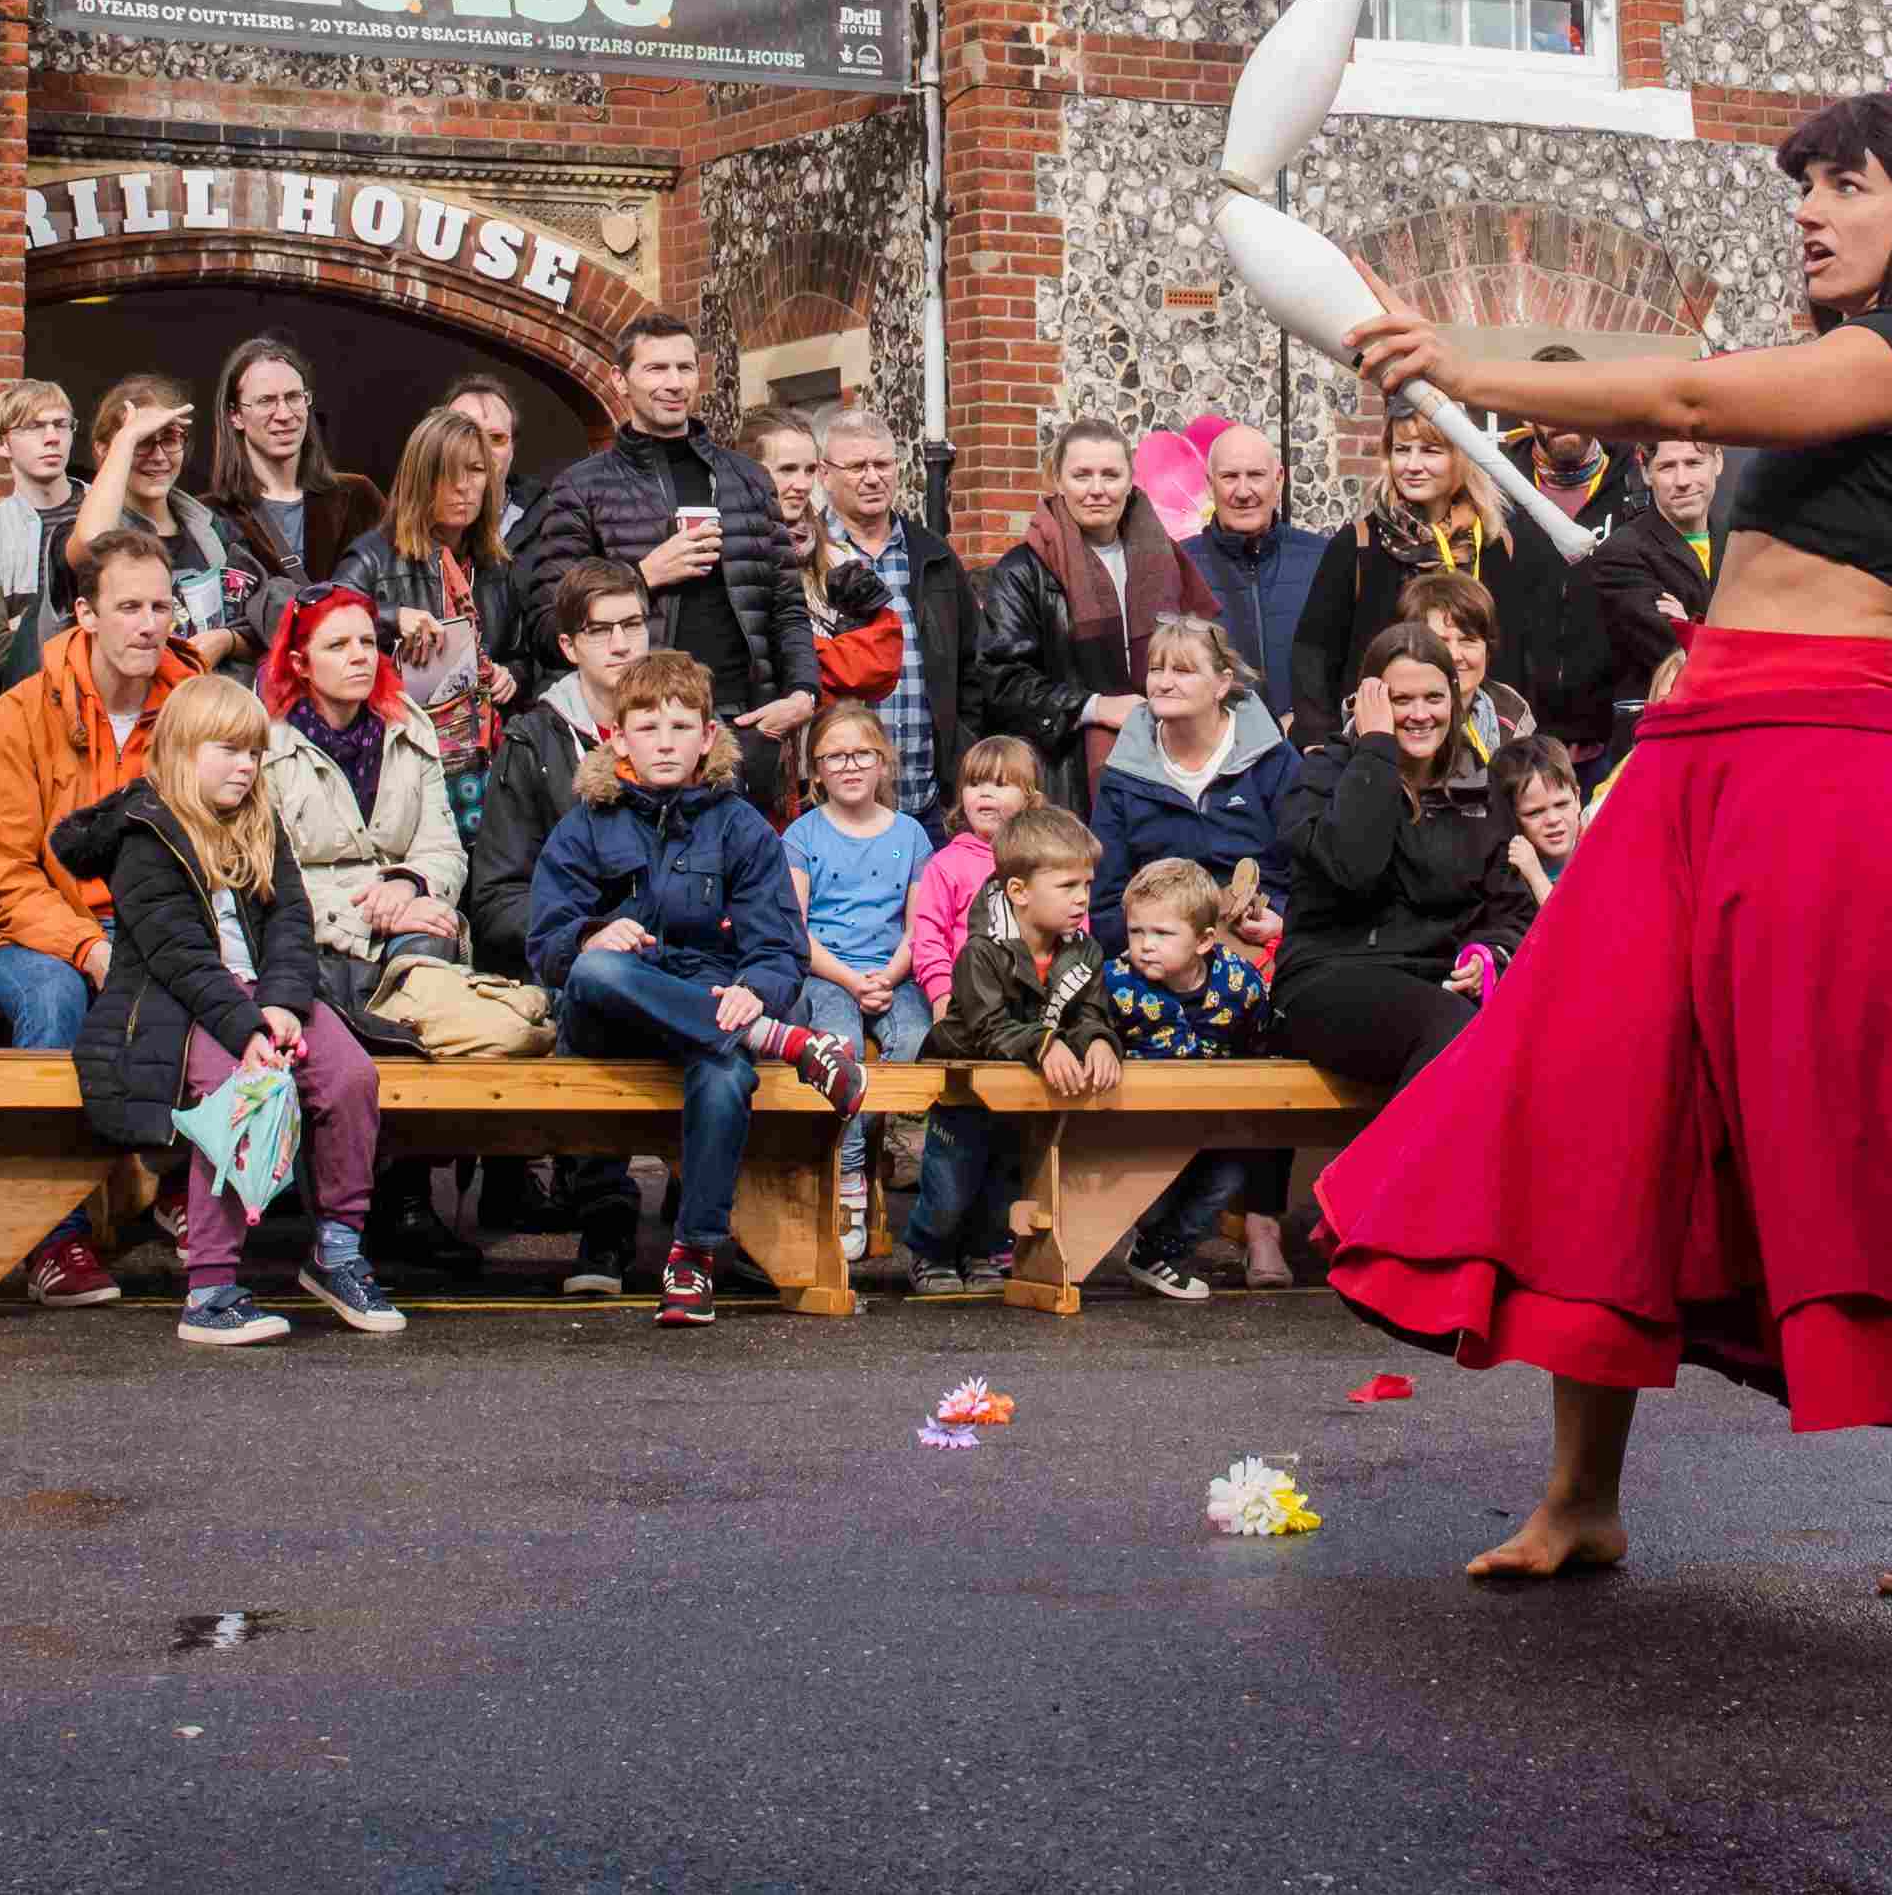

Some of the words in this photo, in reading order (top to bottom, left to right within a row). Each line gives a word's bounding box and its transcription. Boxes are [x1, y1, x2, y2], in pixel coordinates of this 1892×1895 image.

[161, 5, 187, 22] OF
[309, 18, 331, 33] 20
[332, 20, 393, 38] YEARS
[394, 24, 418, 40] OF
[420, 26, 533, 48] SEACHANGE
[546, 33, 575, 51] 150
[577, 36, 633, 55] YEARS
[634, 41, 659, 57] OF
[658, 43, 695, 59] THE
[696, 45, 746, 64] DRILL
[746, 48, 805, 68] HOUSE
[839, 7, 882, 26] Drill
[839, 25, 883, 37] HOUSE
[25, 169, 229, 249] RILL
[277, 172, 581, 305] HOUSE
